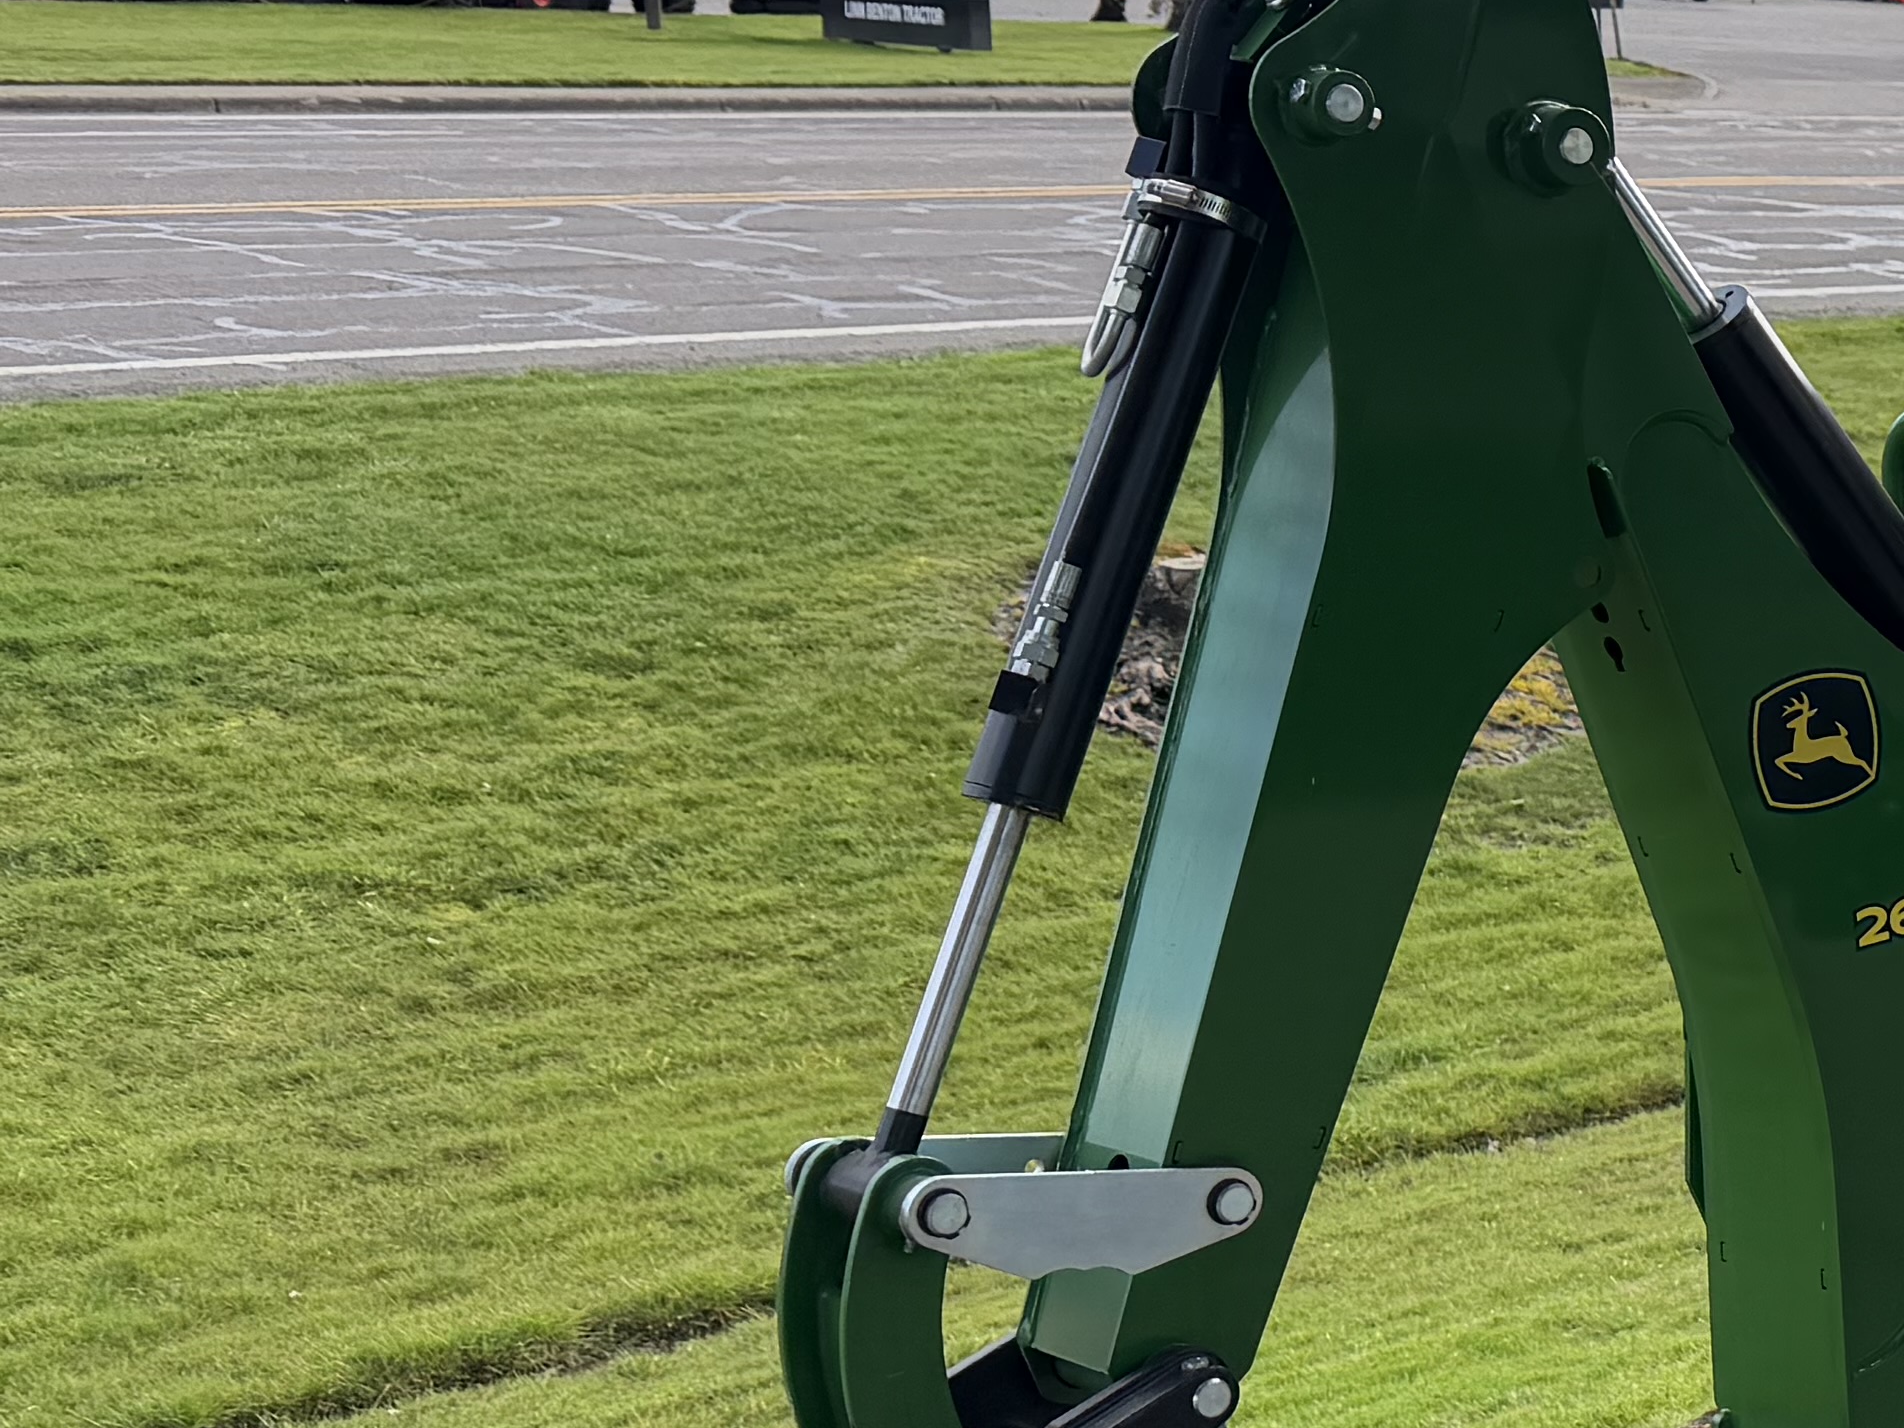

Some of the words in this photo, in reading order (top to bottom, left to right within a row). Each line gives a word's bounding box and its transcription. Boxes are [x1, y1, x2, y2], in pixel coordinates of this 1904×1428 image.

[844, 0, 865, 20] LINN
[866, 2, 901, 23] BENTON
[901, 4, 945, 26] TRACTOR
